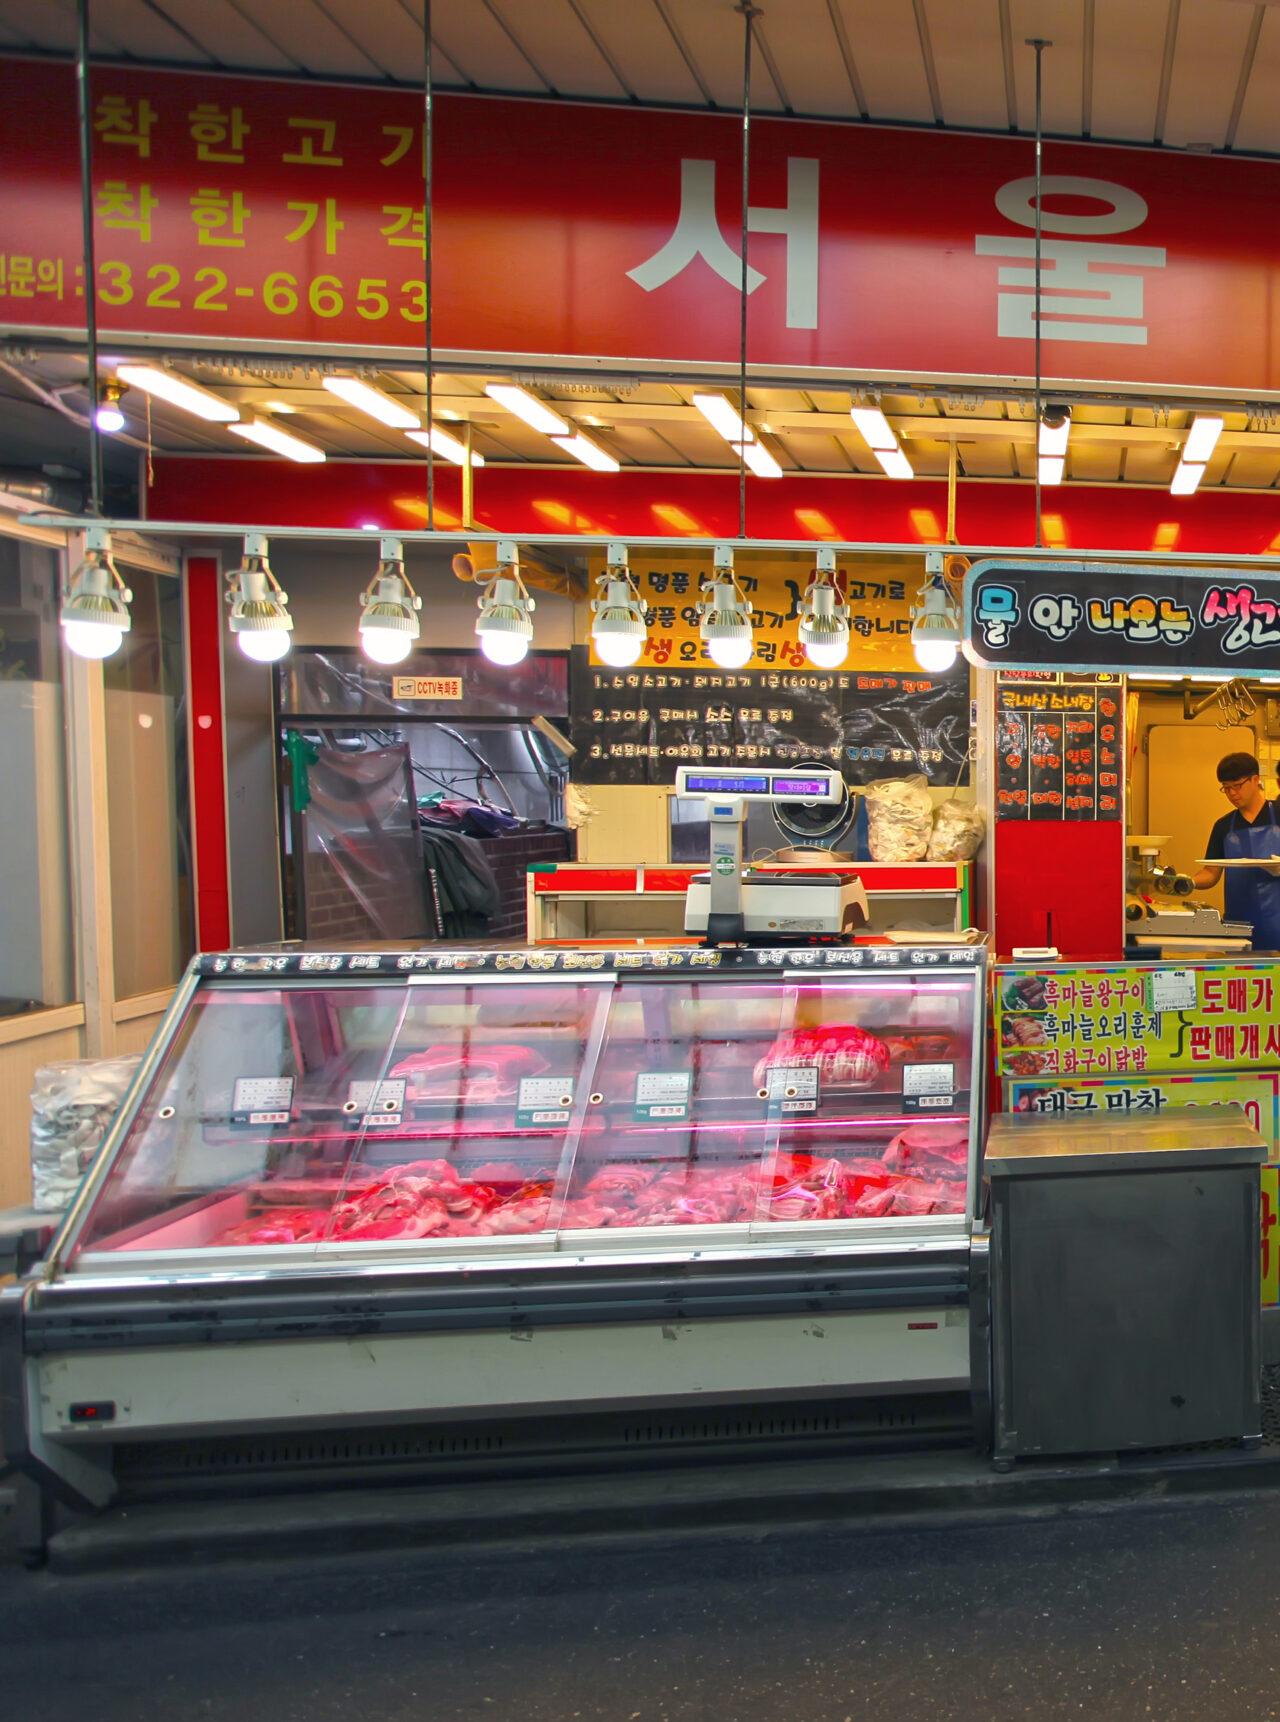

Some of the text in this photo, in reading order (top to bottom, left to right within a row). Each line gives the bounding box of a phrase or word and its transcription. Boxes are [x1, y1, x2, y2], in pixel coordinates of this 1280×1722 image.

[648, 572, 690, 594] 명품
[977, 585, 1018, 646] 물
[1031, 596, 1080, 637] 안
[1088, 597, 1194, 646] 나오는
[1044, 976, 1145, 1009] 흑마늘왕구이
[1202, 976, 1275, 1015] 도매가
[1044, 1012, 1163, 1044] 흑마늘오리훈제
[1045, 1046, 1149, 1073] 직화구이닭발
